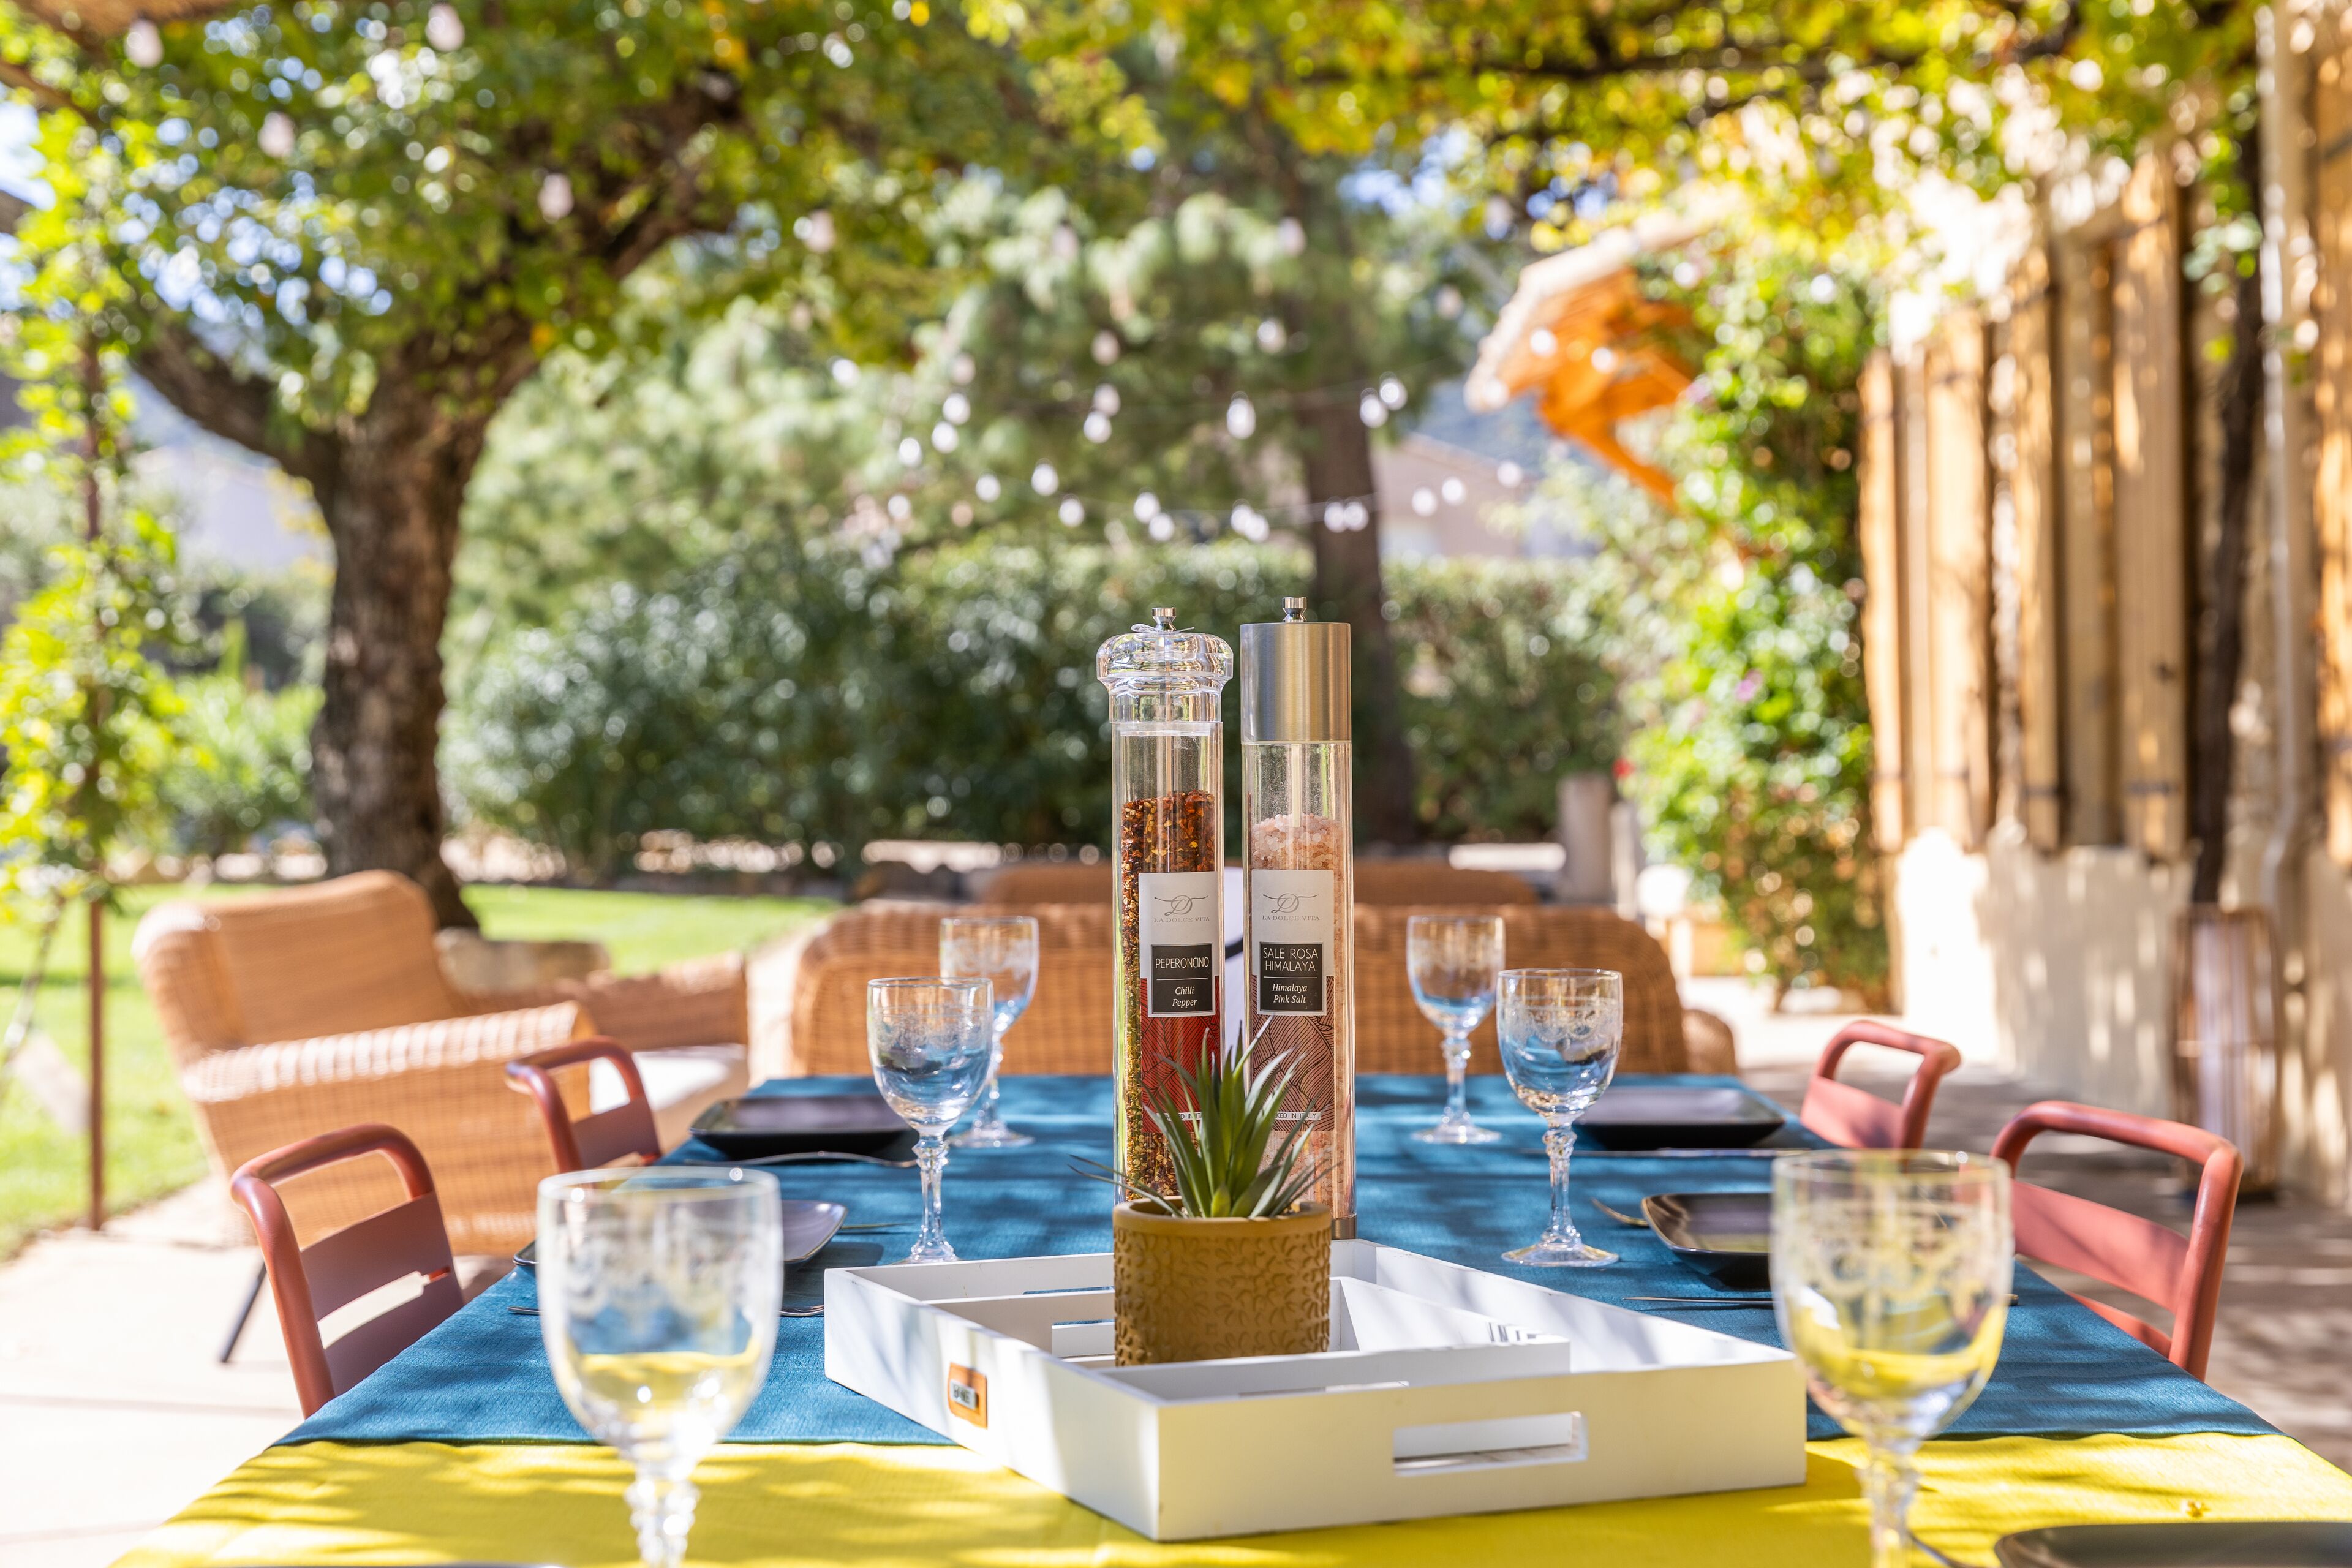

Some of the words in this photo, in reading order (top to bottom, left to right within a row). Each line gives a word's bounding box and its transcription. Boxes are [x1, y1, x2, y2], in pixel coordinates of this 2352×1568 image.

[1263, 948, 1285, 959] SALE
[1290, 948, 1318, 959] ROSA
[1155, 957, 1210, 969] PEPERONCINO
[1265, 960, 1316, 971] HIMALAYA
[1175, 986, 1194, 995] Chilli
[1272, 983, 1308, 993] Himalaya
[1172, 998, 1197, 1008] Pepper
[1273, 995, 1290, 1003] Pink
[1291, 995, 1306, 1003] Salt
